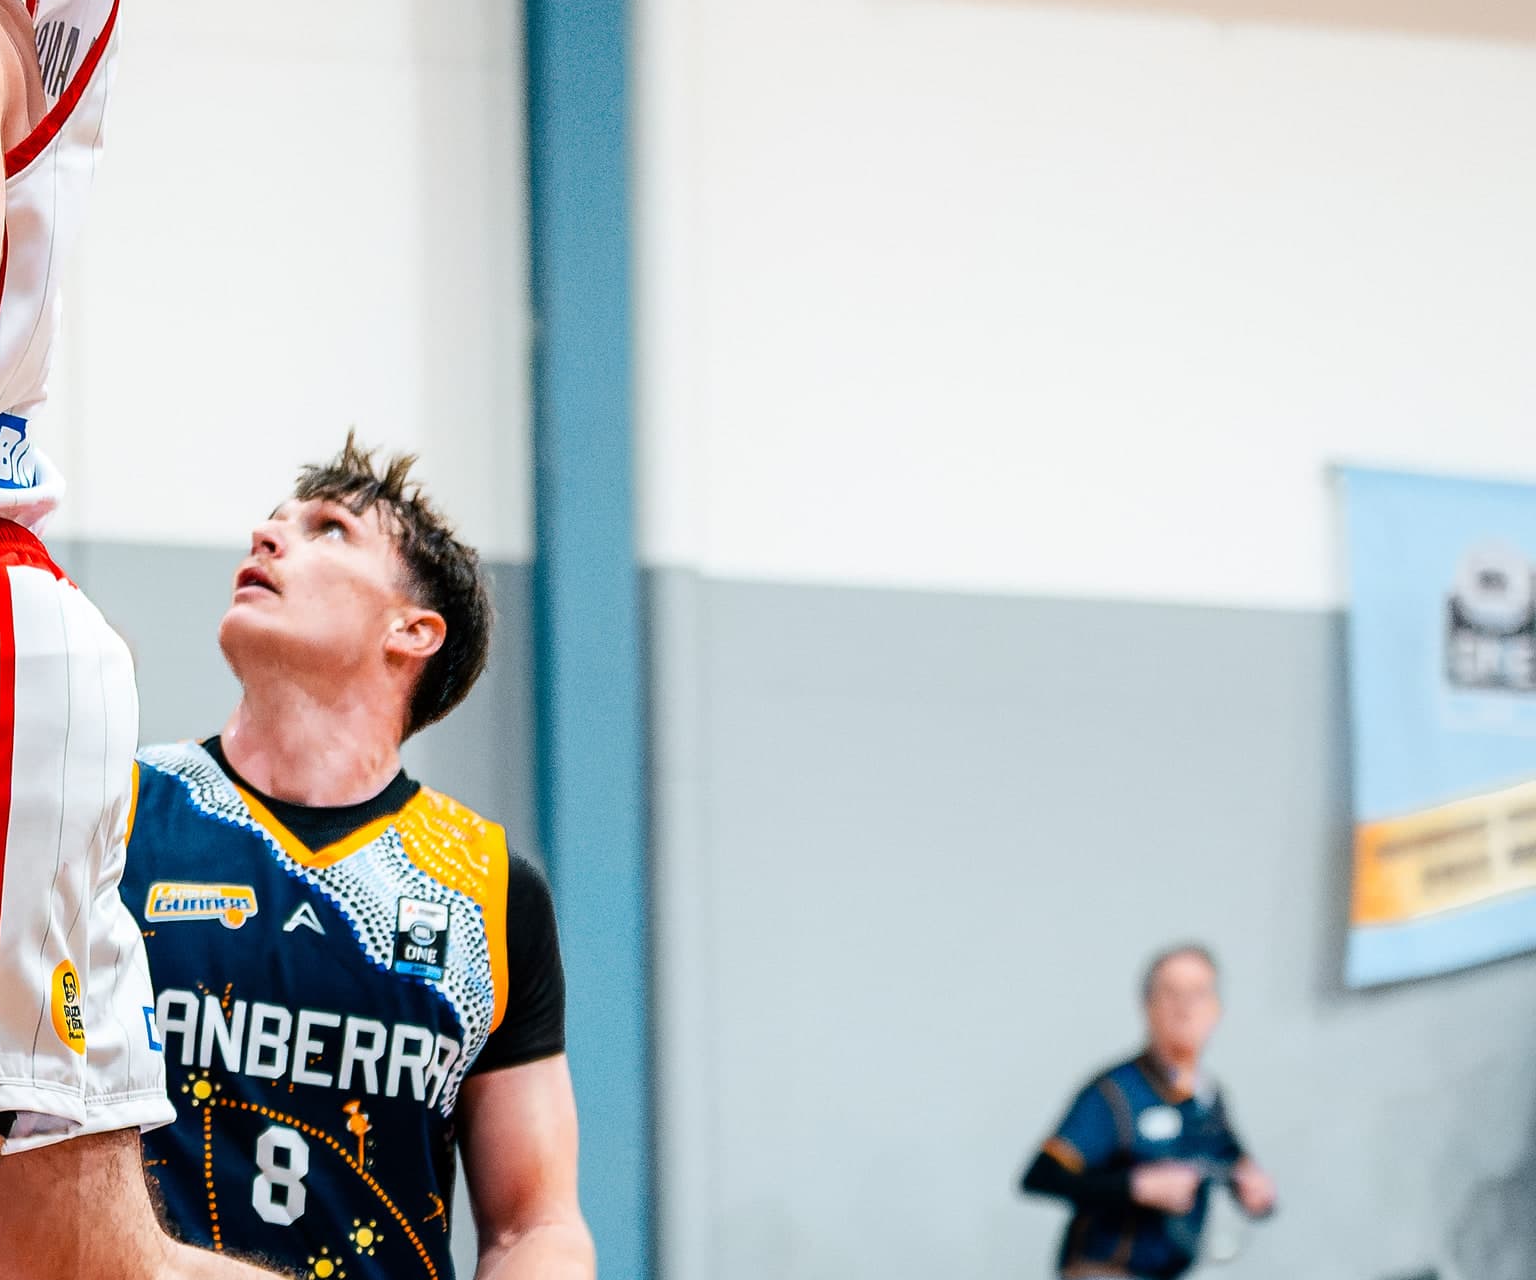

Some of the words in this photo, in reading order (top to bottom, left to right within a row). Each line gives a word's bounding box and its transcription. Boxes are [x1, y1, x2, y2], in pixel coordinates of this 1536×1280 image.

[404, 944, 438, 964] ONE
[156, 988, 460, 1109] ANBERRA
[252, 1124, 309, 1227] 8
